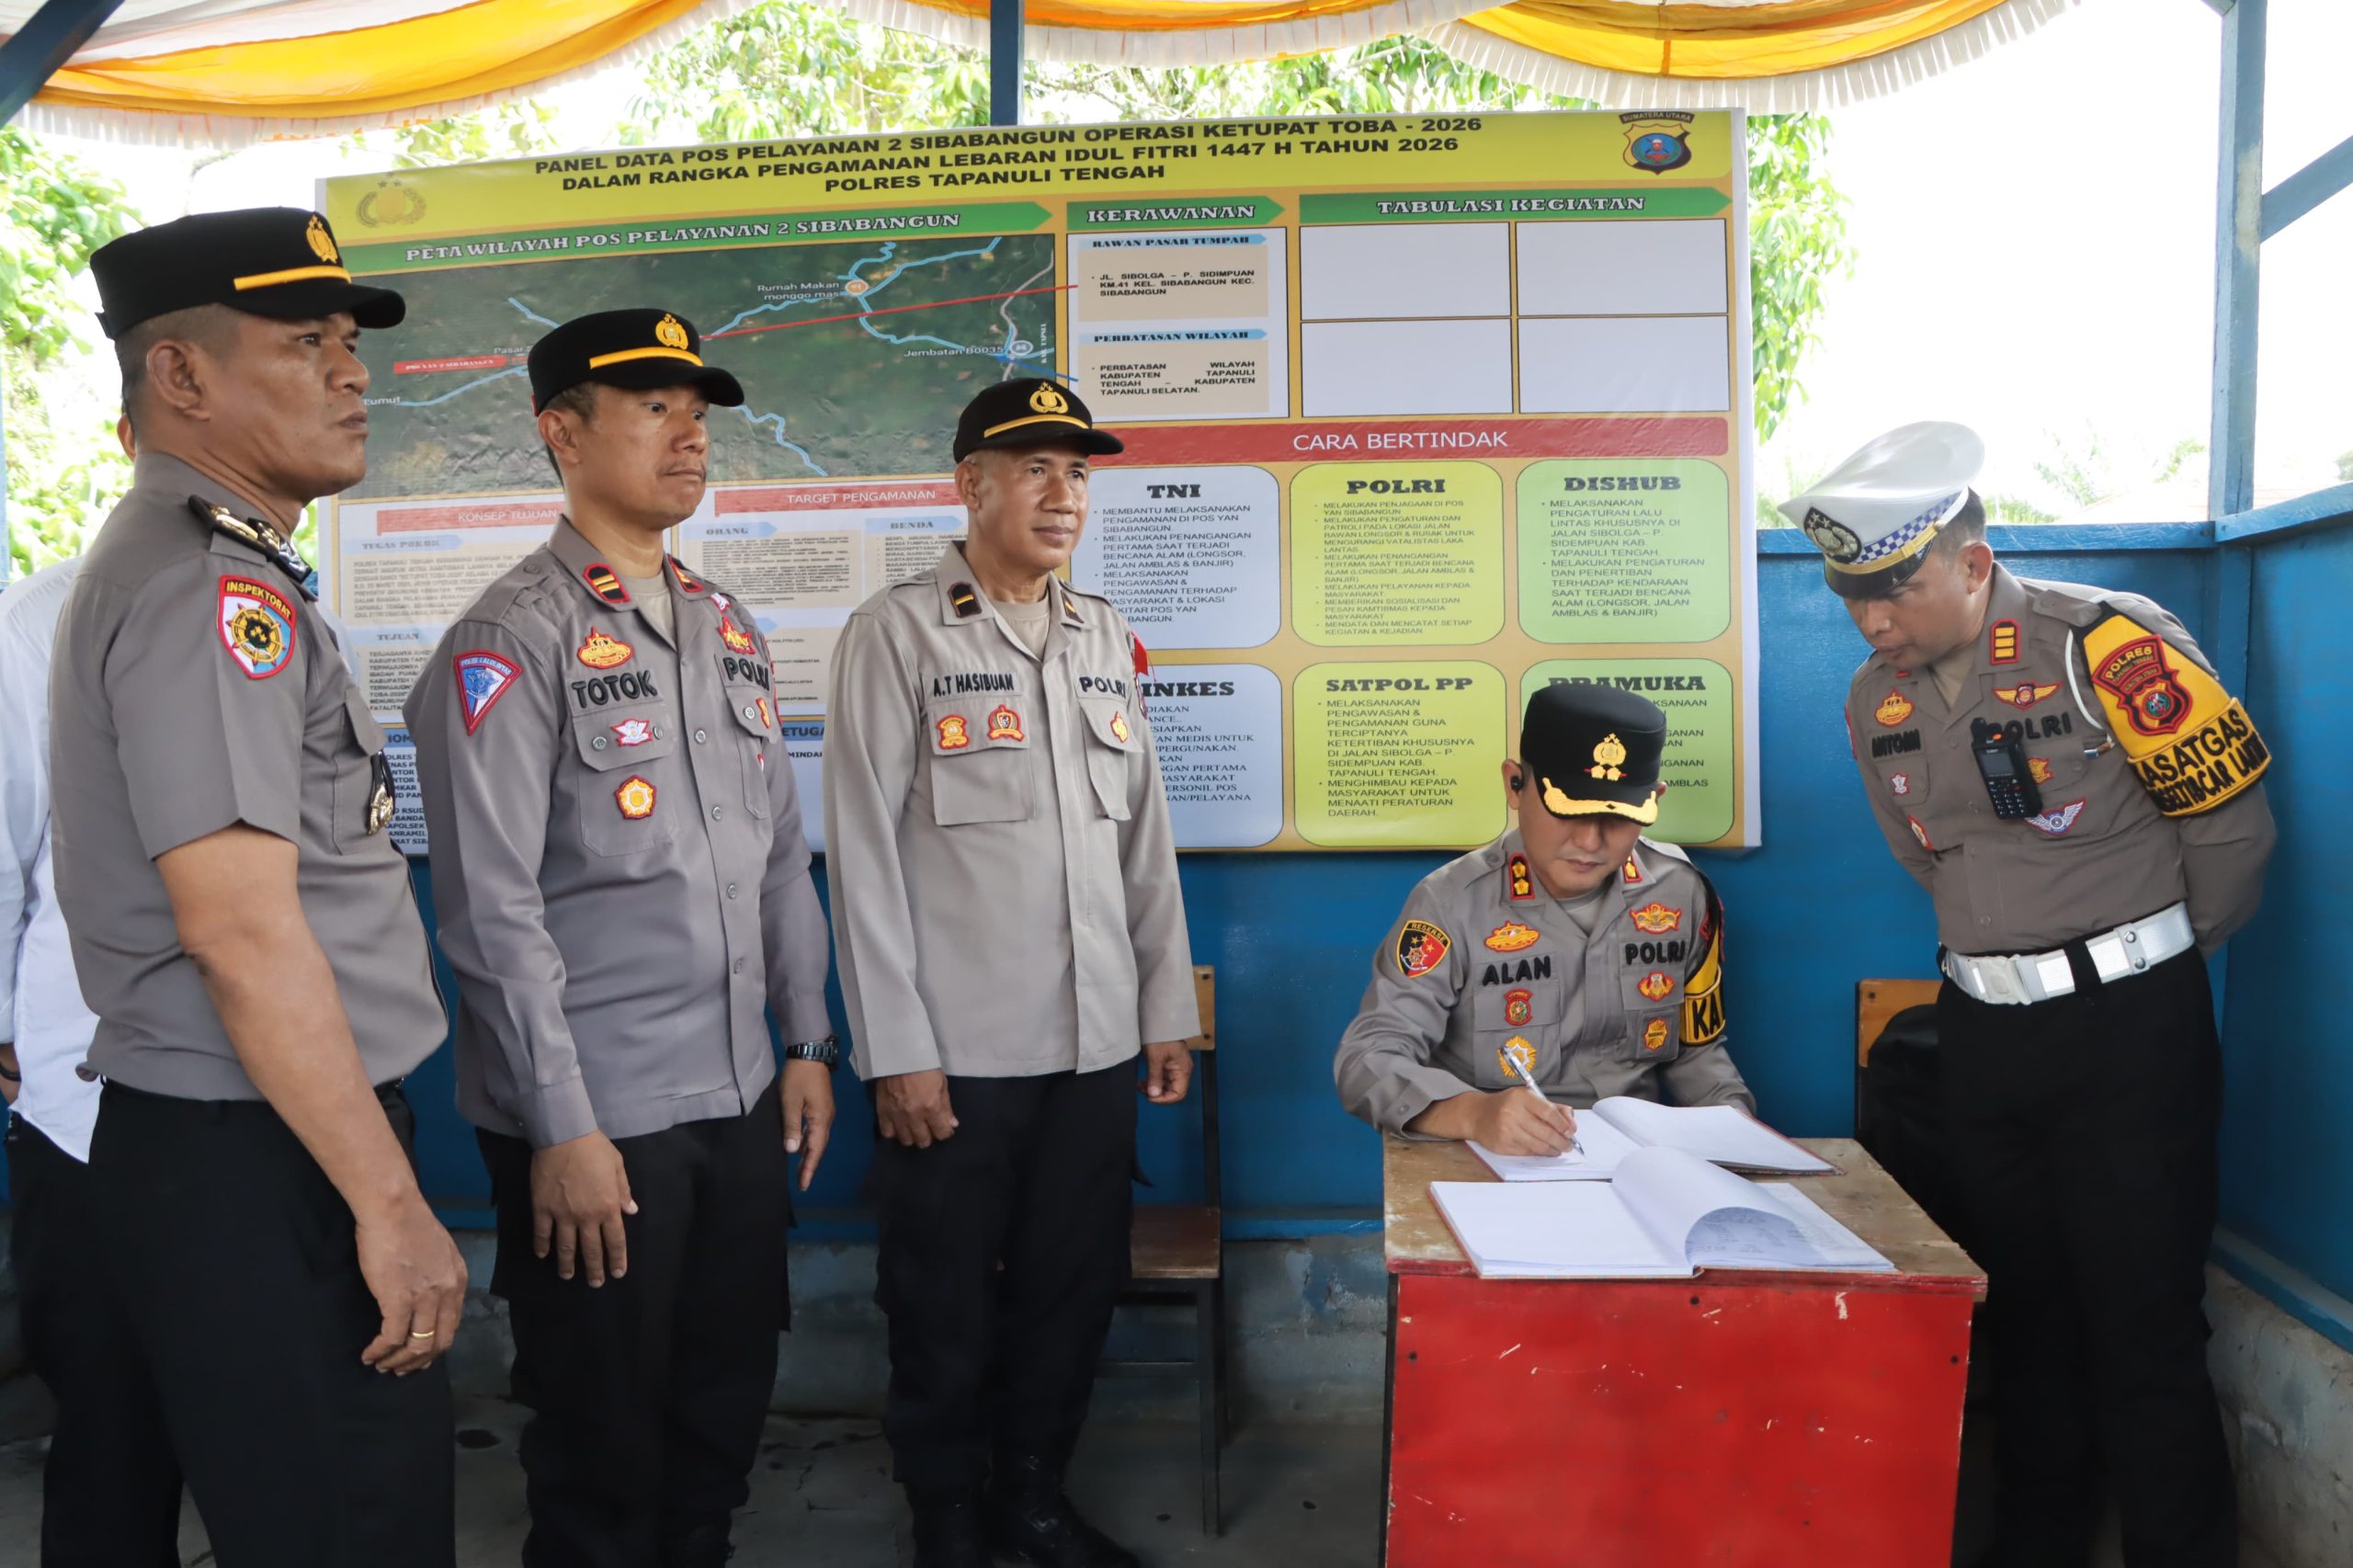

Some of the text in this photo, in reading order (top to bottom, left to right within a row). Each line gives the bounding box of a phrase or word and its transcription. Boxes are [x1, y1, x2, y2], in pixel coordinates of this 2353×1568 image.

[536, 156, 607, 174] PANEL
[616, 153, 674, 167] DATA
[683, 149, 728, 162] POS
[738, 140, 880, 159] PELAYANAN
[889, 139, 901, 151] 2
[910, 130, 1075, 149] SIBABANGUN
[1085, 126, 1195, 141] OPERASI
[1203, 121, 1316, 137] KETUPAT
[1327, 119, 1397, 133] TOBA
[1421, 118, 1482, 131] 2026
[563, 137, 1459, 190] DALAM RANGKA PENGAMANAN LEBARAN IDUL FITRI 1447 H TAHUN 2026
[825, 165, 1165, 192] POLRES TAPANULI TENGAH
[1377, 198, 1645, 213] TABULASI KEGIATAN
[1086, 205, 1255, 222] KERAWANAN
[405, 213, 961, 261] PETA WILAYAH POS PELAYANAN 2 SIBABANGUN
[1092, 236, 1249, 247] RAWAN PASAR TUMPAH
[801, 281, 839, 290] Makan
[1161, 278, 1226, 287] SIBABANGUN
[764, 292, 814, 301] monggo
[1094, 331, 1248, 342] PERBATASAN WILAYAH
[904, 347, 963, 358] Jembatan
[1293, 430, 1508, 451] CARA BERTINDAK
[1347, 479, 1445, 494] POLRI
[1564, 476, 1681, 491] DISHUB
[1147, 484, 1201, 499] TNI
[788, 491, 936, 504] TARGET PENGAMANAN
[1550, 499, 1643, 507] MELAKSANAKAN
[459, 508, 558, 522] KONSEP TUJUAN
[1103, 506, 1251, 515] MEMBANTU MELAKSANAKAN
[1550, 509, 1630, 517] PENGATURAN
[890, 521, 934, 529] BENDA
[1103, 516, 1176, 524] PENGAMANAN
[1550, 519, 1591, 528] LINTAS
[1594, 518, 1665, 527] KHUSUSNYA
[1103, 525, 1171, 533] SIBABANGUN
[1551, 529, 1586, 538] JALAN
[1590, 528, 1641, 537] SIBOLGA
[1103, 532, 1251, 542] MELAKUKAN PENANGANGAN
[1103, 543, 1153, 551] PERTAMA
[1104, 570, 1188, 578] MELAKSANAKAN
[1552, 589, 1581, 597] SAAT
[226, 581, 291, 619] INSPEKTORAT
[377, 632, 420, 641] TUJUAN
[2105, 646, 2154, 680] POLRES
[571, 669, 658, 709] TOTOK
[933, 674, 1015, 697] A.T HASIBUAN
[1079, 676, 1126, 699] POLRI
[1142, 682, 1234, 697] INKES
[1326, 677, 1472, 692] SATPOL PP
[1327, 699, 1420, 708] MELAKSANAKAN
[1327, 709, 1404, 717] PENGAWASAN
[1327, 719, 1409, 727] PENGAMANAN
[1327, 738, 1475, 747] KETERTIBAN KHUSUSNYA
[1328, 789, 1405, 797] MASYARAKAT
[1412, 923, 1445, 942] RESERSE
[1625, 940, 1686, 965] POLRI
[1482, 956, 1551, 986] ALAN
